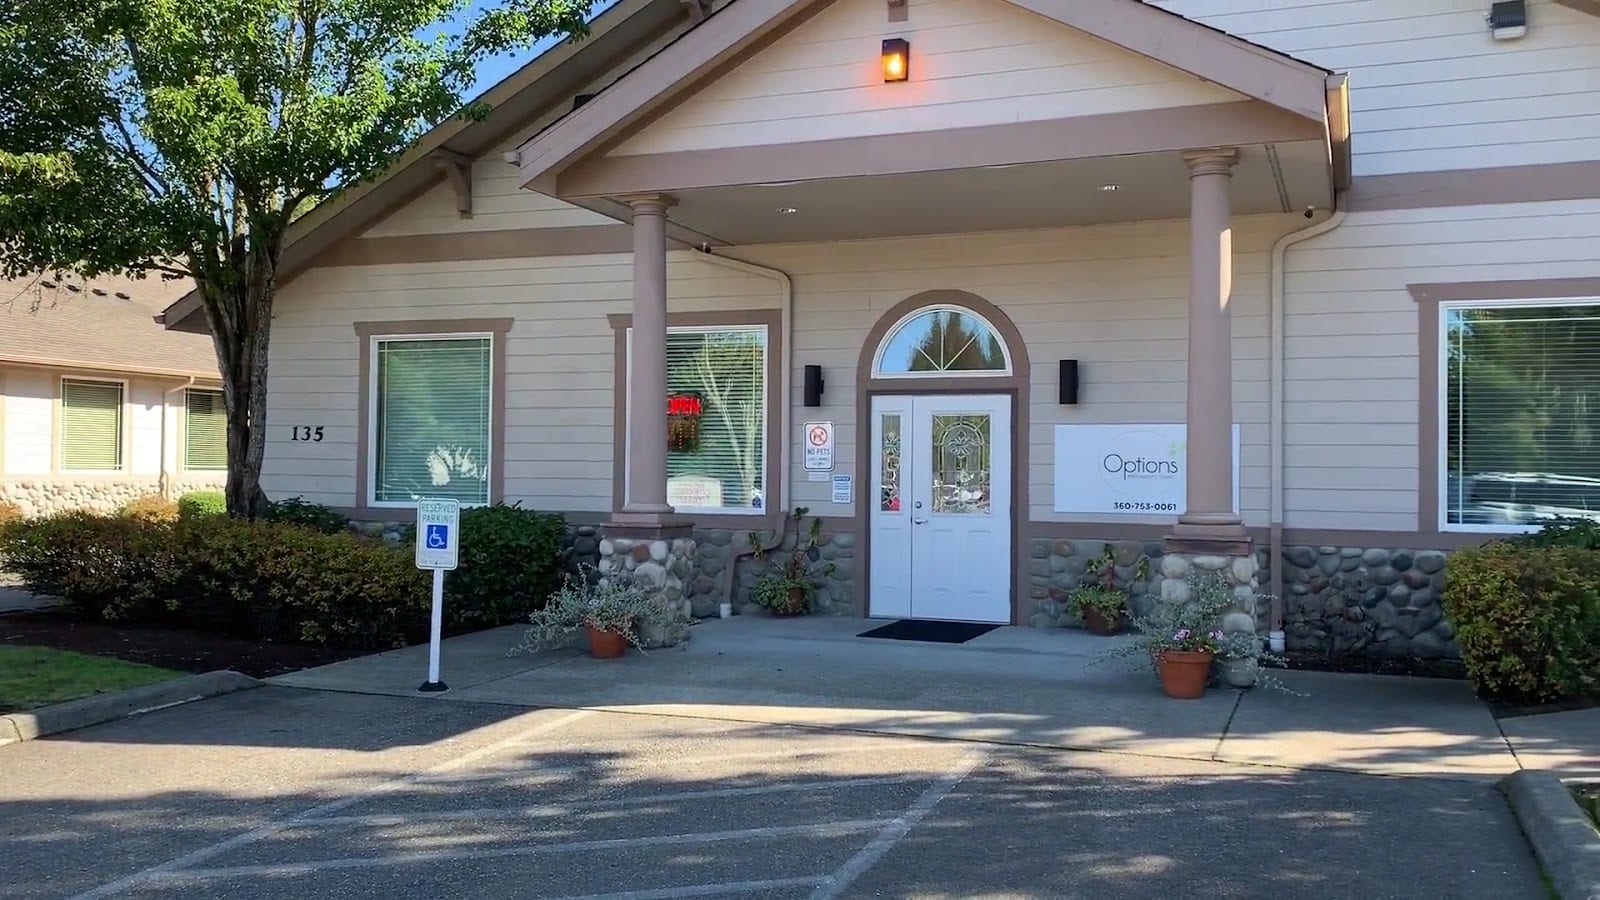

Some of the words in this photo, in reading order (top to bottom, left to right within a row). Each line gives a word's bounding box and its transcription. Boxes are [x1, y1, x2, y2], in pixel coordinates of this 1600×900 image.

[291, 425, 325, 441] 135
[817, 448, 830, 456] PETS
[1104, 453, 1178, 480] Options
[421, 503, 456, 513] RESERVED
[1113, 502, 1177, 511] 360-753-0061
[422, 514, 455, 524] PARKING
